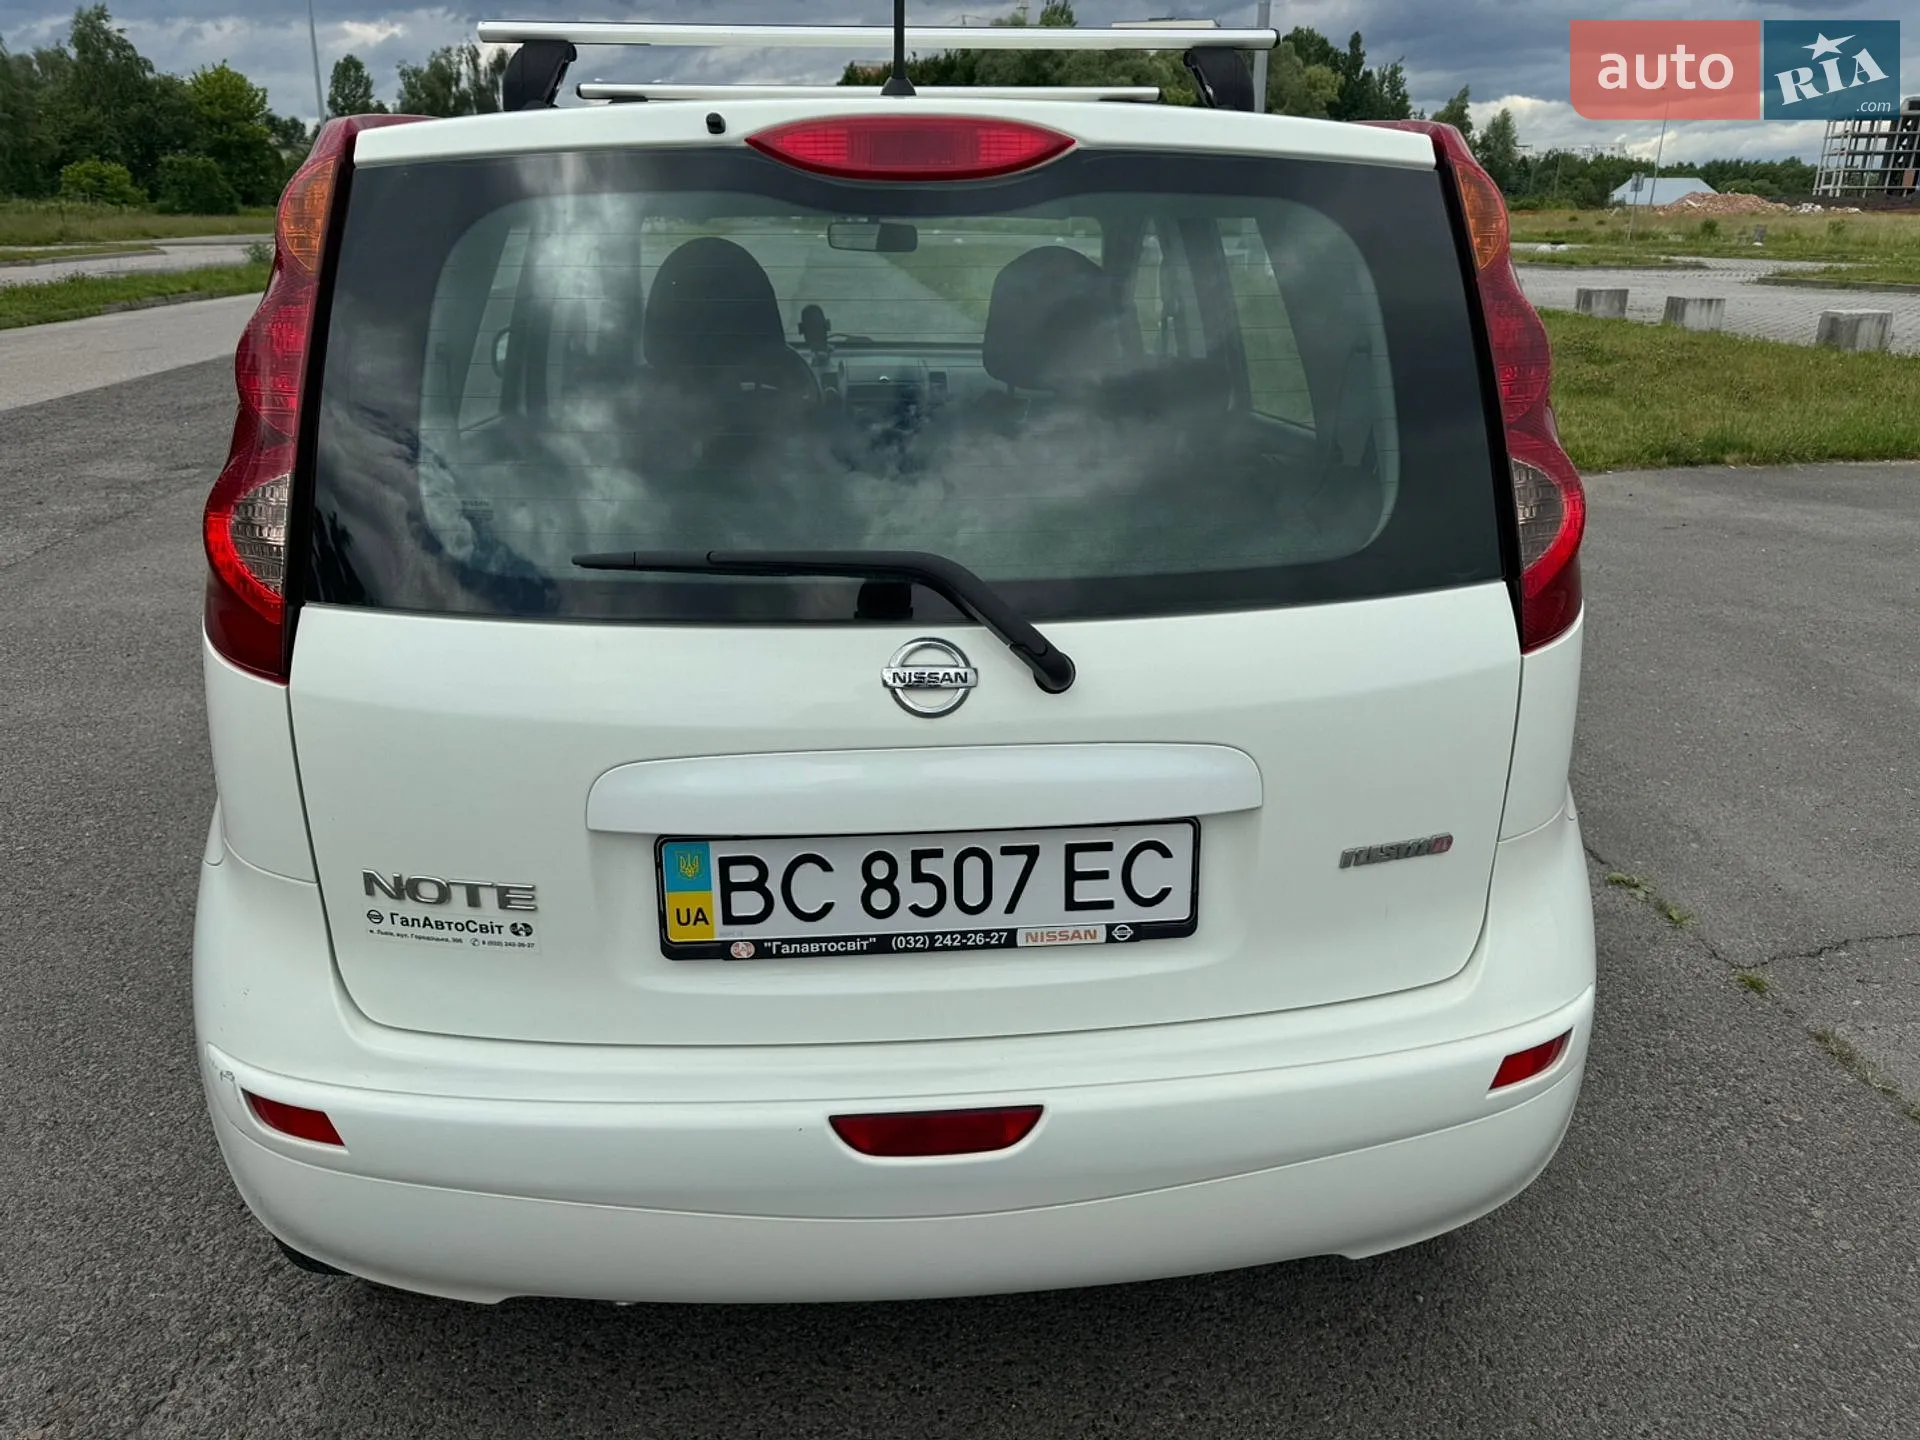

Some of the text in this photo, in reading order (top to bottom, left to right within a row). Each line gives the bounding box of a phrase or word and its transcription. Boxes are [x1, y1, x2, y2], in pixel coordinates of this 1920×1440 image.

[892, 671, 968, 684] NISSAN
[362, 868, 539, 912] NOTE
[718, 840, 1174, 925] BC 8507 EC
[389, 911, 505, 935] ГалАвтоСвіт
[676, 907, 710, 927] UA
[891, 931, 1008, 950] (032) 242-26-27
[1025, 929, 1098, 943] NISSAN
[764, 938, 877, 954] "Галавтосвіт"
